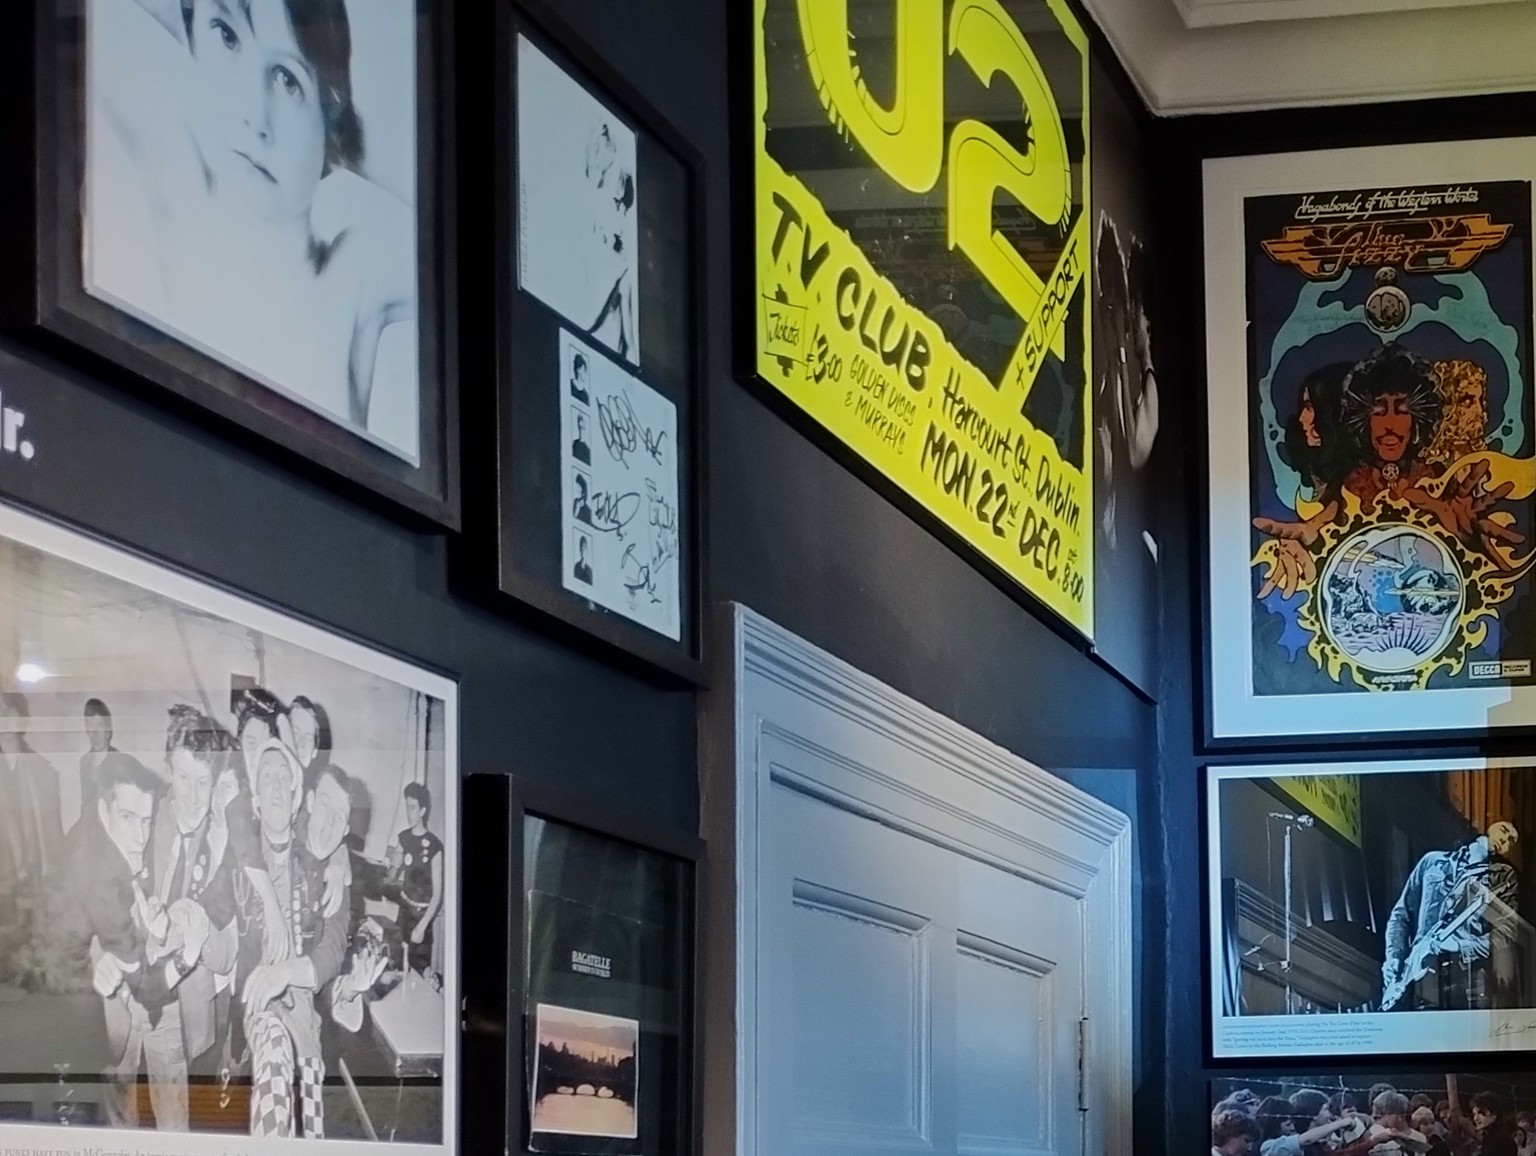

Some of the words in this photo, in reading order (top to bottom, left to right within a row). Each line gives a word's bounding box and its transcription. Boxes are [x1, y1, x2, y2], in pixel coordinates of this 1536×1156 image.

[1024, 239, 1078, 371] SUPPORT
[942, 366, 1012, 469] Harcourt
[1474, 664, 1501, 675] DECCA
